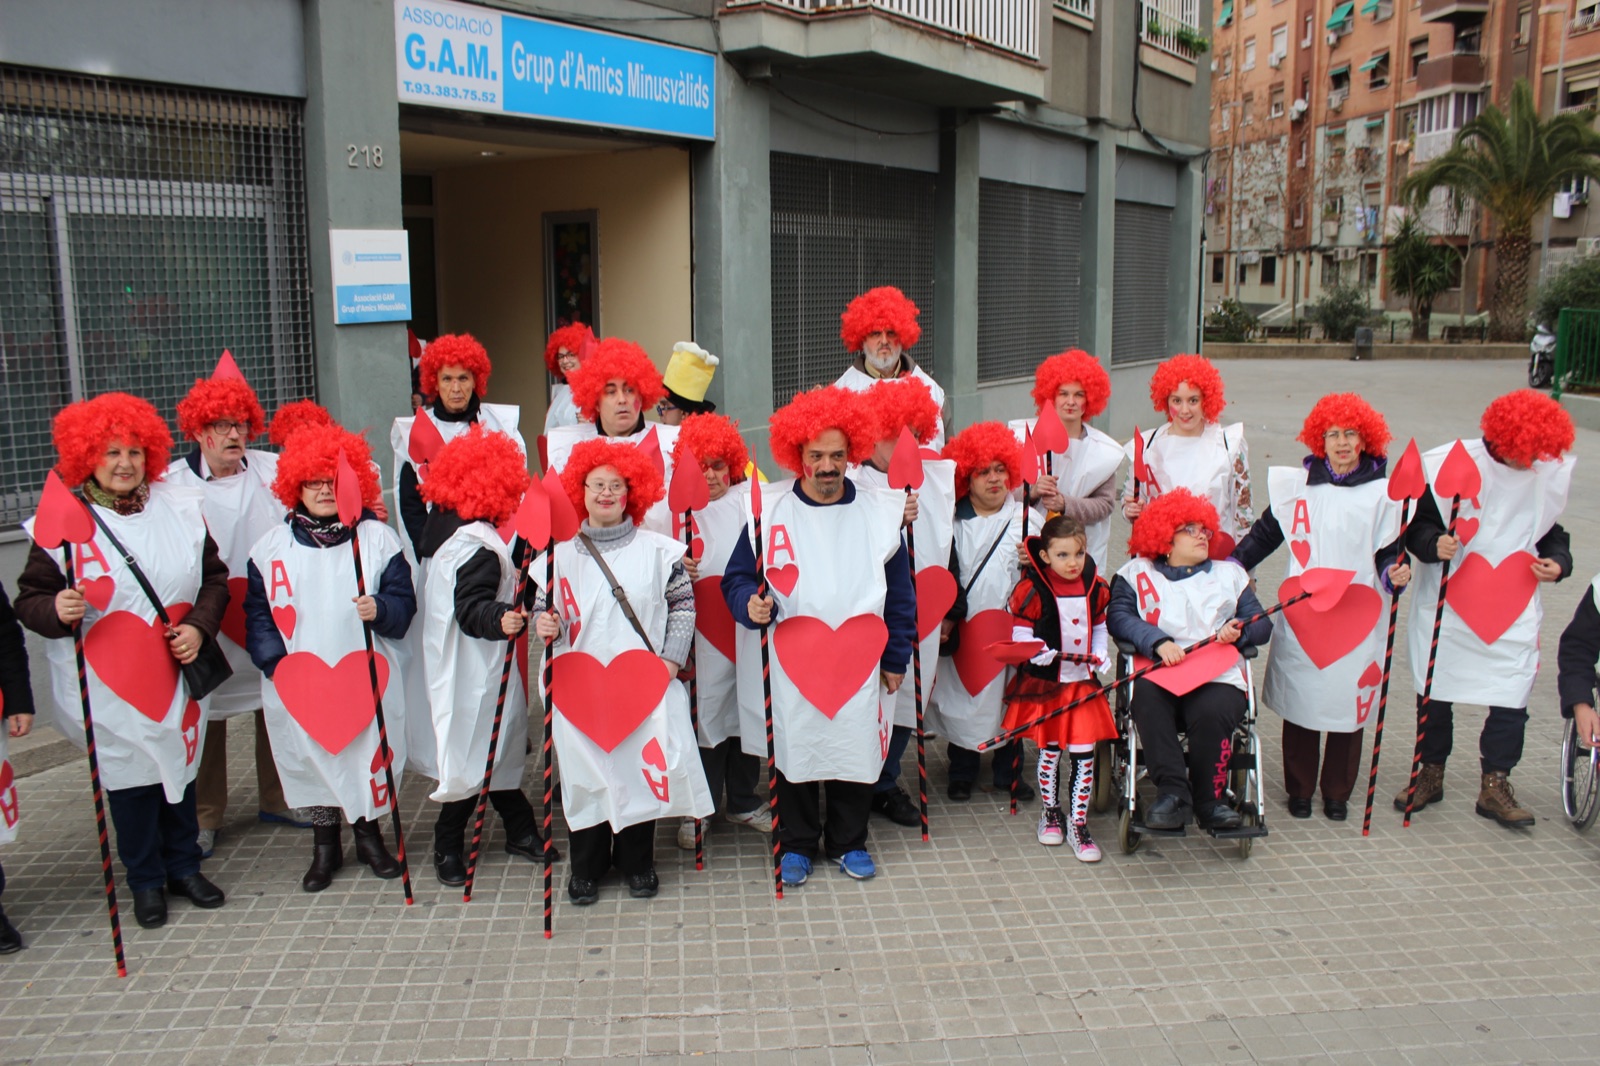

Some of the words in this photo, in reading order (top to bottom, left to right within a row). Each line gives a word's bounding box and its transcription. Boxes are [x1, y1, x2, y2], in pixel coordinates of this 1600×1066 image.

[402, 6, 493, 36] ASSOCIACIÓ
[405, 32, 497, 81] G.A.M.
[511, 40, 554, 94] Grup
[627, 61, 709, 109] Minusvàlids
[403, 81, 496, 103] T.93.383.75.52
[347, 144, 383, 169] 218
[1291, 499, 1310, 534] A
[767, 525, 795, 565] A
[270, 560, 293, 601] A
[560, 577, 581, 620] A
[1136, 571, 1160, 610] A
[641, 768, 669, 803] A
